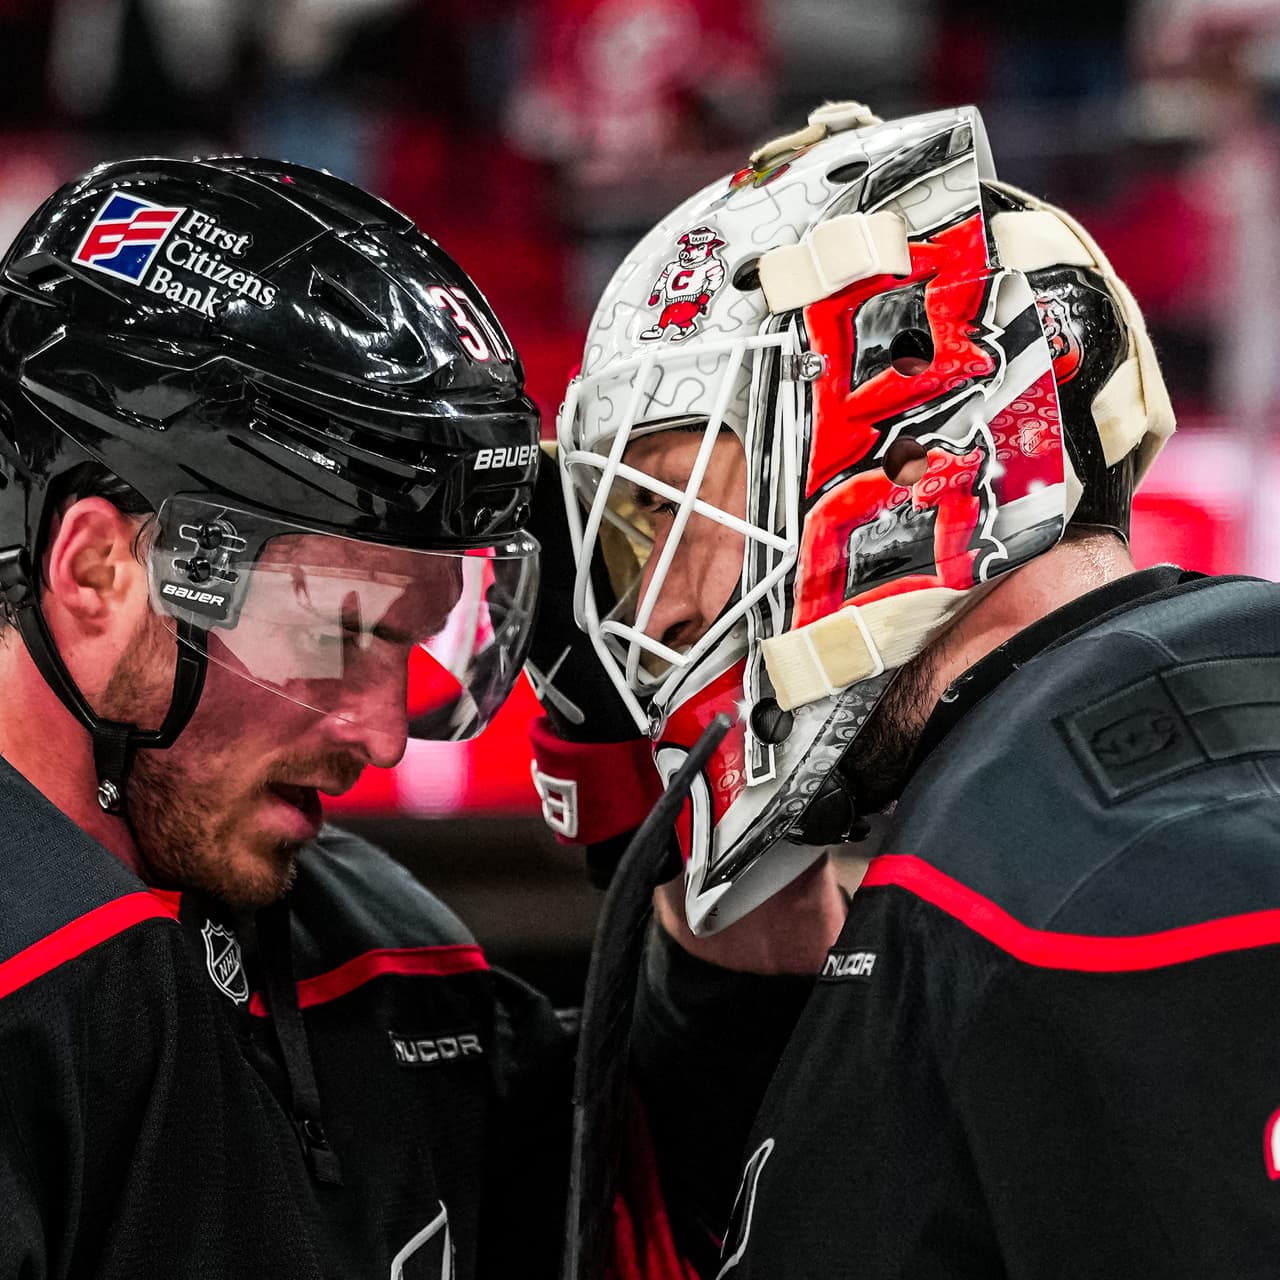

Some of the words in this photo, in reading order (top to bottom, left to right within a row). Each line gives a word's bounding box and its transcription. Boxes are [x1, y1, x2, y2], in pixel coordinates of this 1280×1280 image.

[180, 209, 249, 255] First
[145, 265, 222, 318] Bank
[166, 238, 276, 306] Citizens
[672, 270, 695, 291] C
[162, 583, 225, 607] BAUER
